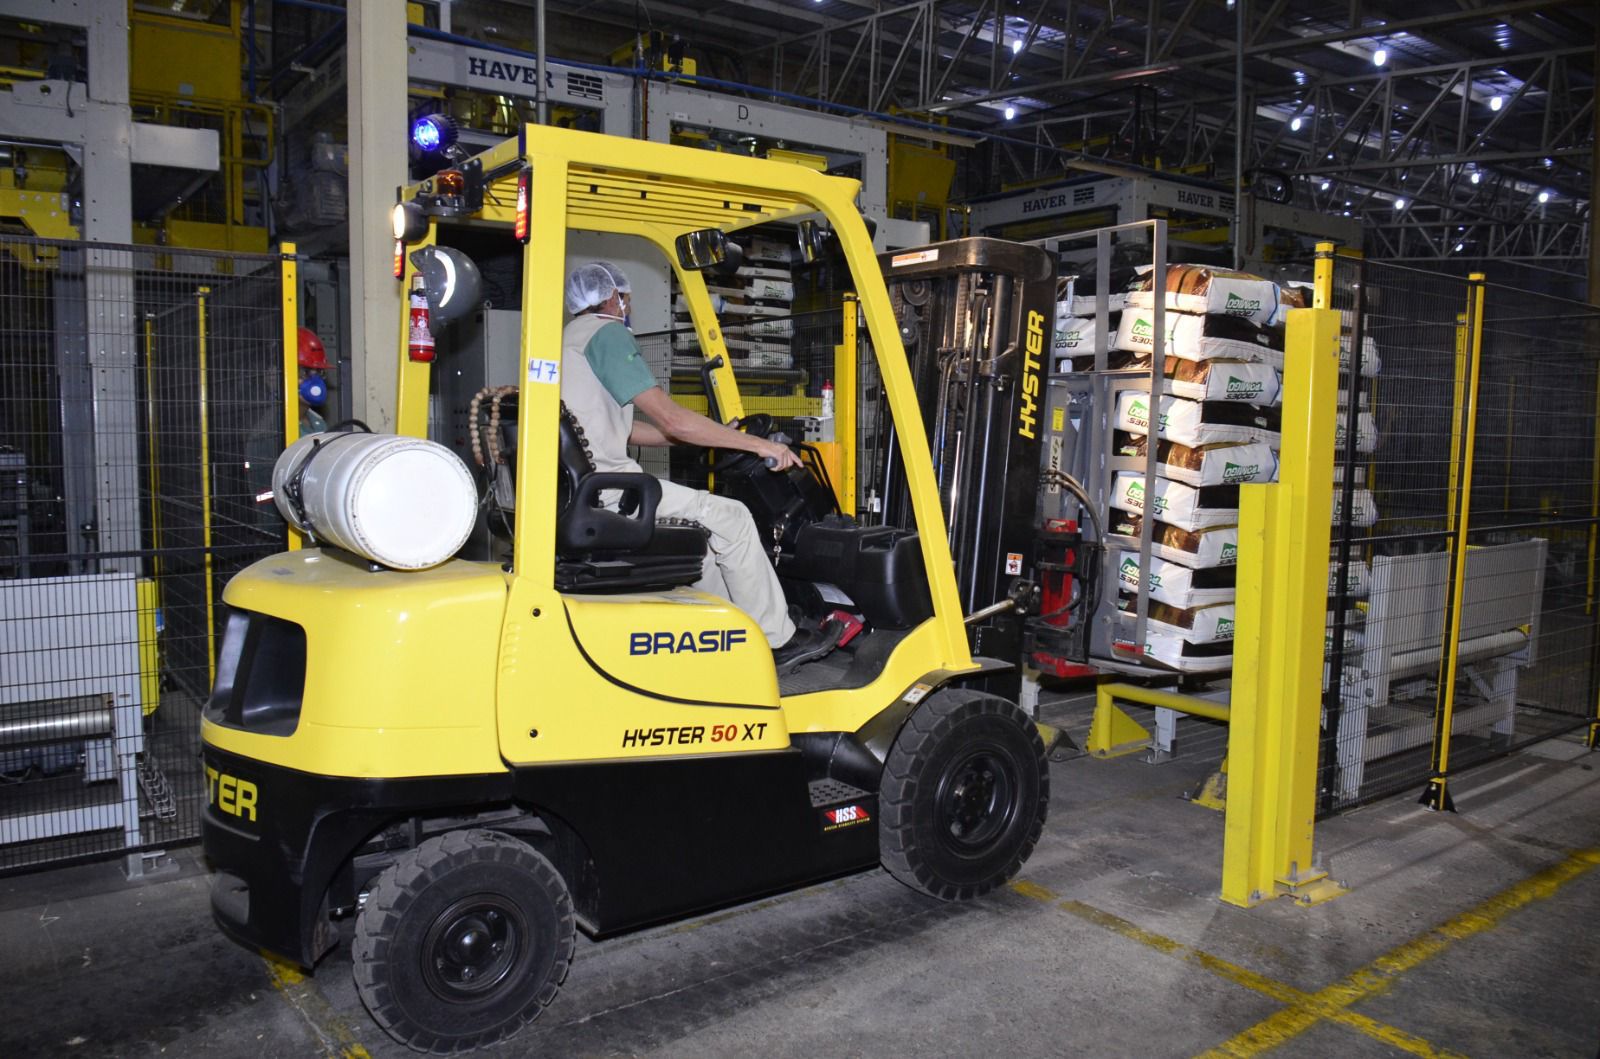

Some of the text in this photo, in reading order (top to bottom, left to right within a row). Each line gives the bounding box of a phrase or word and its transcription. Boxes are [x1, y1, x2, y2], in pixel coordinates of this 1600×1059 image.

[738, 105, 749, 120] D
[1023, 195, 1067, 213] HAVER
[1178, 190, 1214, 208] HAVER
[531, 359, 557, 381] 47
[1019, 310, 1045, 440] HYSTER
[630, 629, 747, 656] BRASIF
[622, 723, 768, 748] HYSTER 50 XT
[207, 766, 258, 822] TER
[835, 805, 857, 824] HSS
